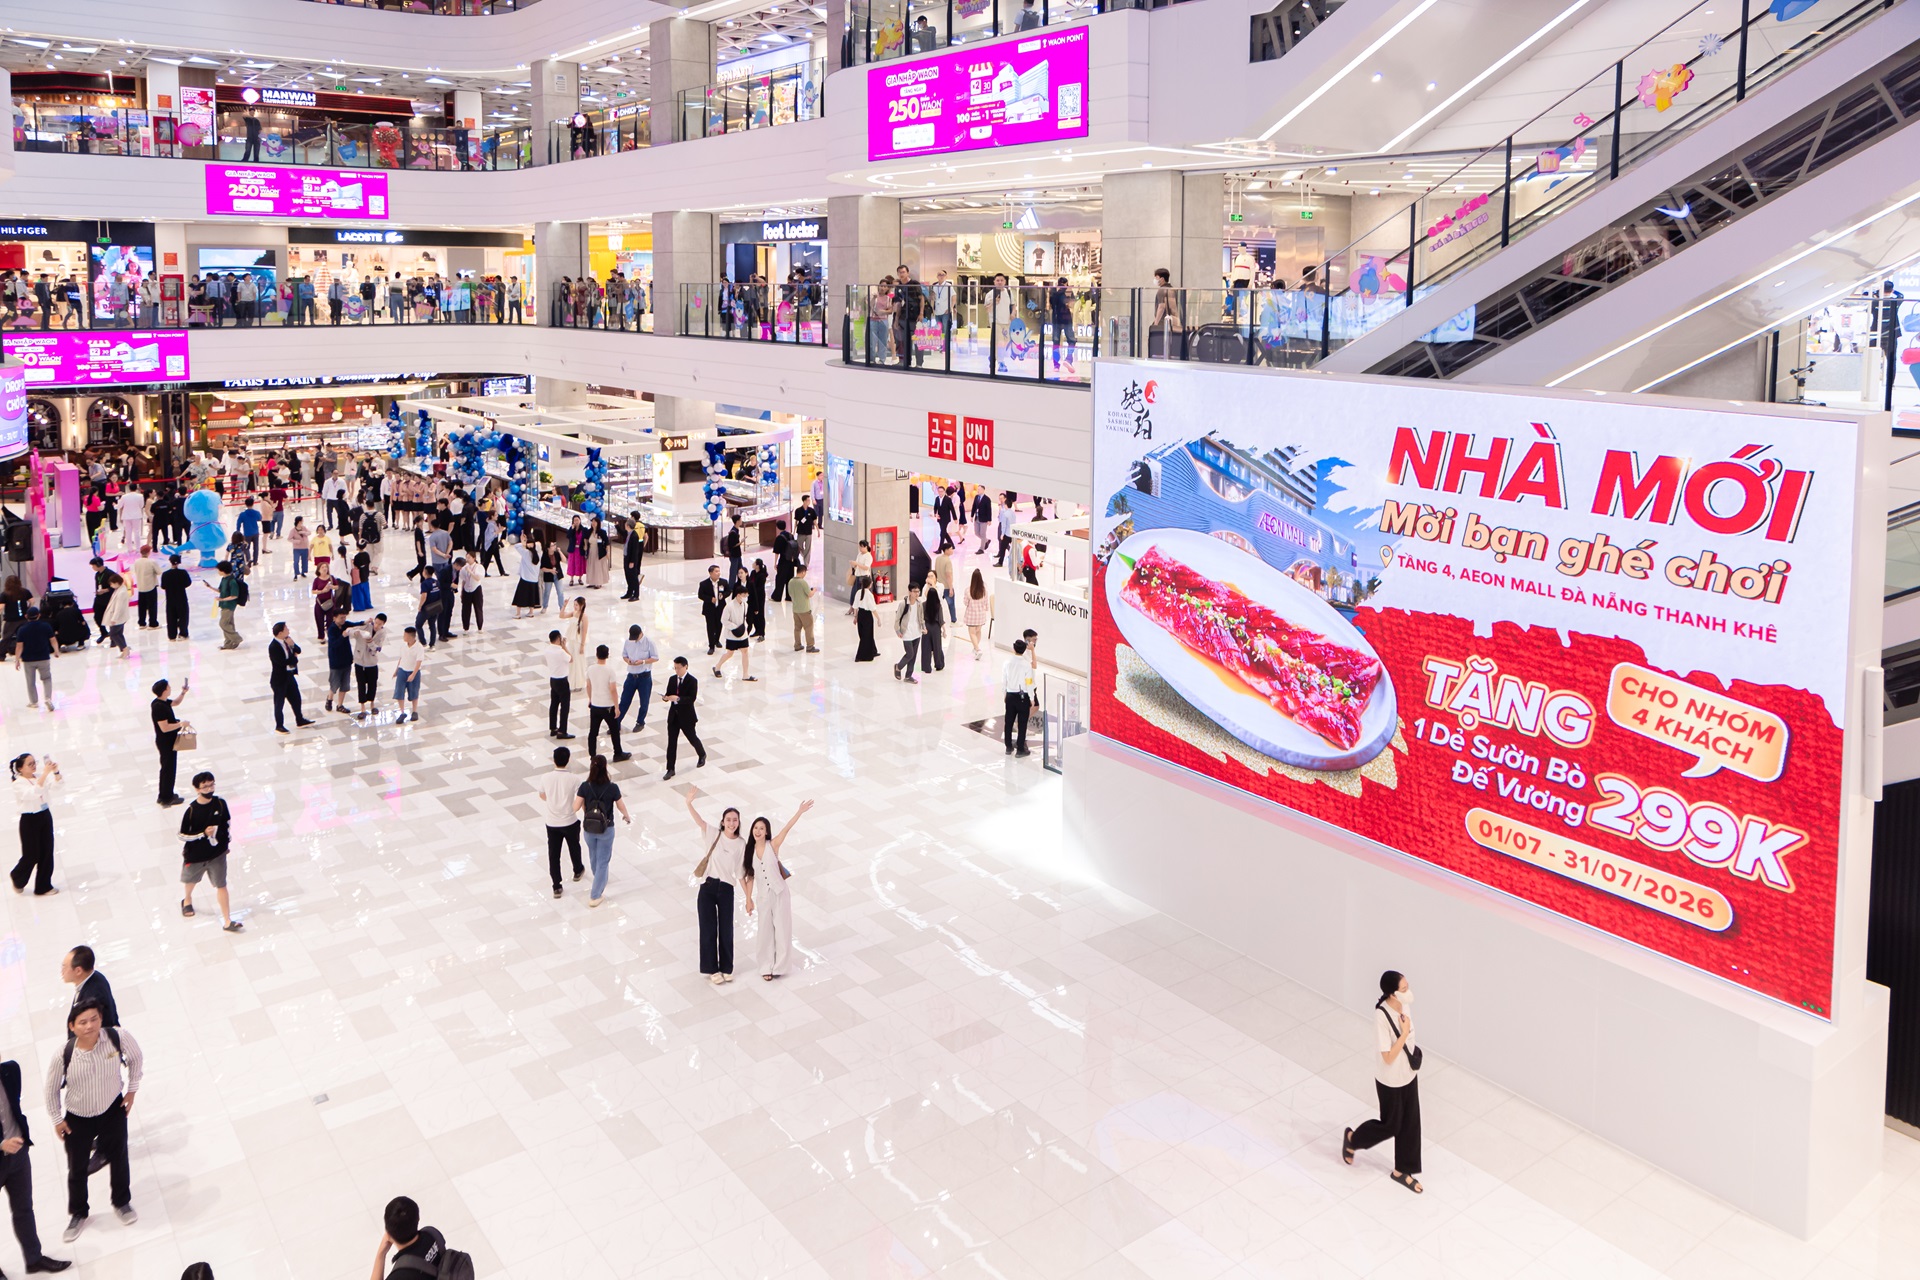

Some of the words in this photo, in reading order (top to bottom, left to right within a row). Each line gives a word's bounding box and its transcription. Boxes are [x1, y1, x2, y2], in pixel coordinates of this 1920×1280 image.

[1047, 37, 1066, 47] WAON
[1066, 32, 1085, 44] POINT
[886, 74, 898, 87] GIA
[898, 69, 917, 85] NHẬP
[917, 67, 938, 80] WAON
[262, 89, 317, 103] MANWAH
[920, 99, 942, 112] WAON
[888, 97, 920, 123] 250
[228, 183, 260, 198] 250
[0, 227, 48, 235] HILFIGER
[337, 231, 383, 242] LACOSTE
[763, 222, 784, 240] Foot
[785, 220, 820, 239] Locker
[1107, 410, 1132, 420] KOHAKU
[1107, 417, 1132, 427] SASHIMI
[931, 417, 953, 437] ユニ
[966, 422, 988, 442] UNI
[1105, 425, 1135, 434] YAKINIKU
[673, 437, 687, 449] PNJ
[931, 436, 953, 456] クロ
[965, 441, 990, 462] QLO
[1385, 421, 1568, 510] NHÀ
[1590, 443, 1815, 544] MỚI
[1012, 528, 1049, 543] INFORMATION
[1284, 523, 1306, 547] MALL
[1379, 499, 1458, 544] Mời
[1462, 512, 1549, 563] bạn
[1556, 532, 1659, 580] ghé
[1664, 549, 1792, 604] chơi
[1023, 591, 1046, 608] QUẦY
[1047, 598, 1077, 616] THÔNG
[1397, 552, 1438, 574] TẦNG
[1442, 564, 1455, 580] 4,
[1459, 568, 1506, 588] AEON
[1510, 577, 1556, 598] MALL
[1561, 586, 1587, 605] ĐÀ
[1592, 591, 1648, 617] NẴNG
[1653, 604, 1727, 633] THANH
[1733, 620, 1778, 644] KHÊ
[1424, 656, 1594, 748] TẶNG
[1620, 676, 1679, 709] CHO
[1684, 697, 1777, 745] NHÓM
[1632, 708, 1650, 726] 4
[1654, 714, 1754, 765] KHÁCH
[1413, 717, 1427, 740] 1
[1429, 721, 1466, 753] Dẻ
[1470, 734, 1540, 775] Sườn
[1545, 756, 1587, 790] Bò
[1451, 759, 1496, 791] Đế
[1496, 772, 1586, 828] Vương
[1589, 775, 1806, 891] 299K
[1478, 818, 1542, 856] 01/07
[1563, 848, 1716, 920] 31/07/2026
